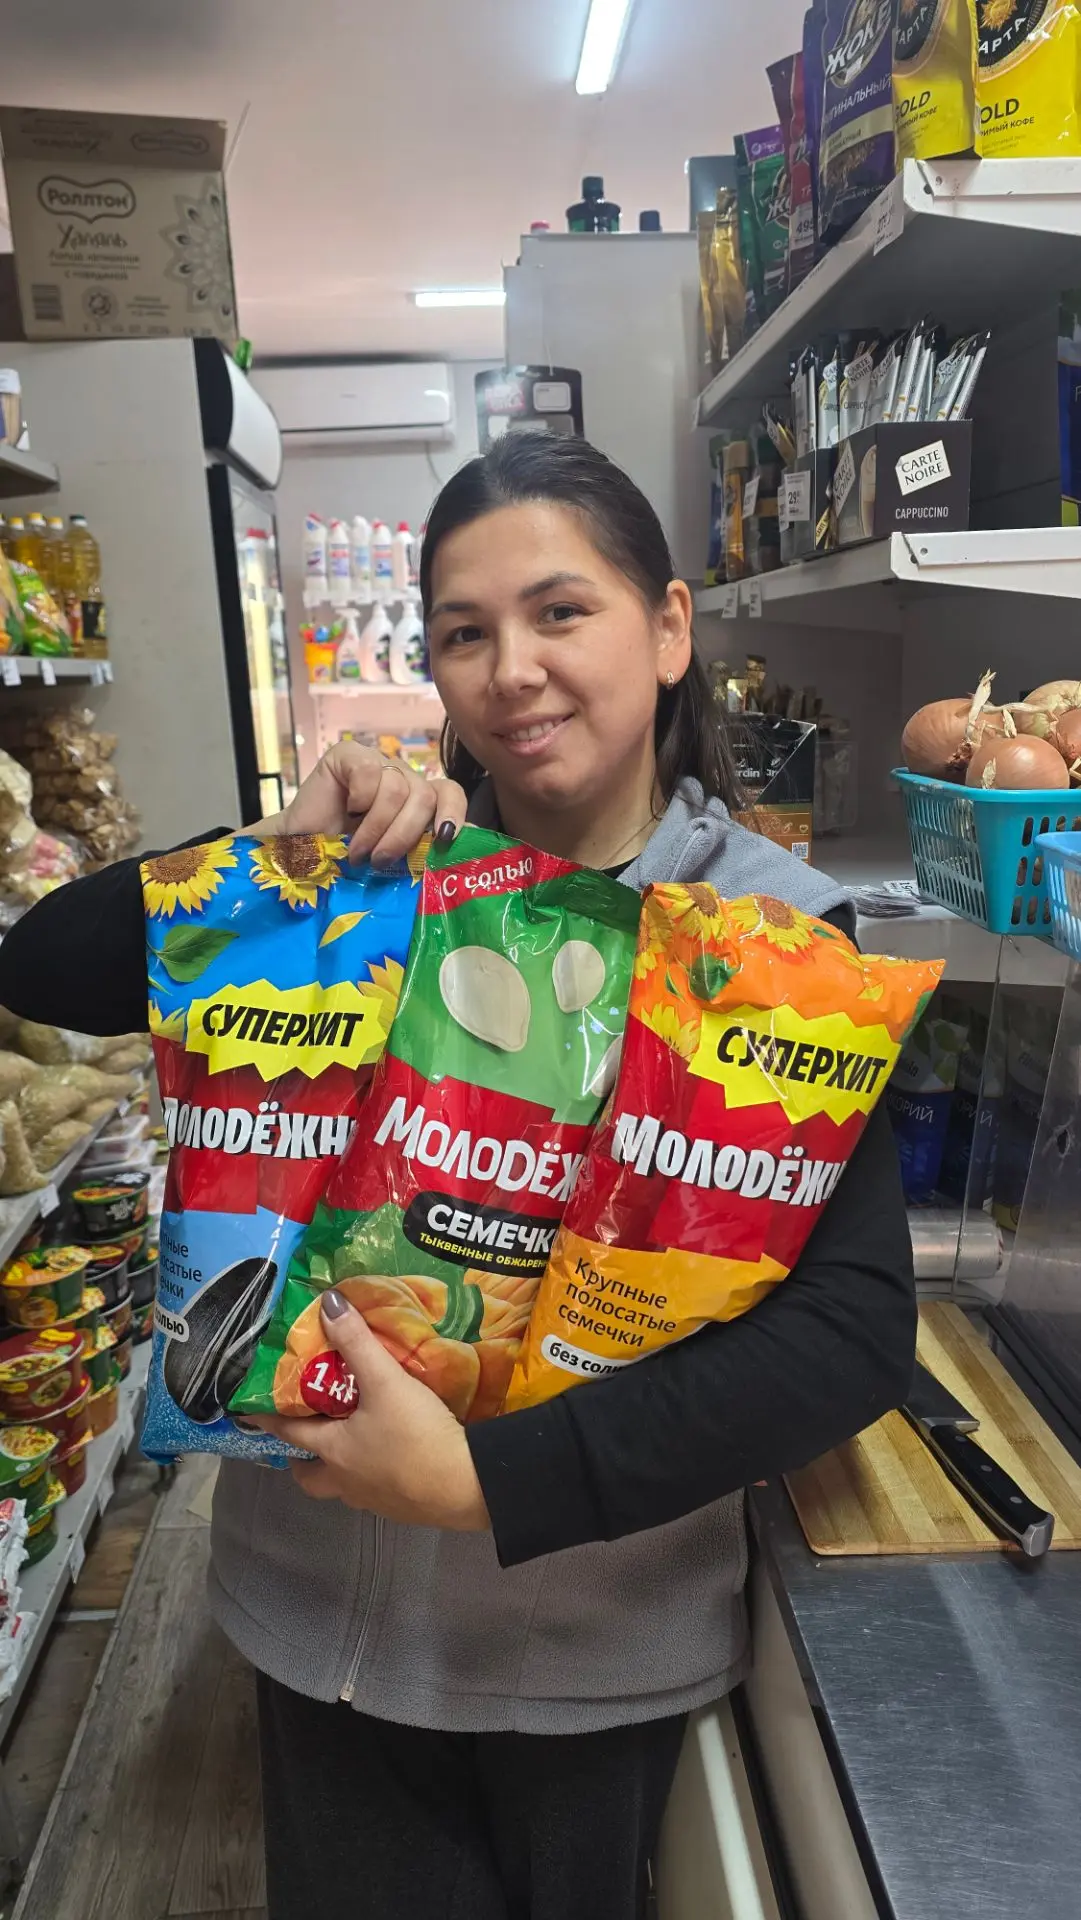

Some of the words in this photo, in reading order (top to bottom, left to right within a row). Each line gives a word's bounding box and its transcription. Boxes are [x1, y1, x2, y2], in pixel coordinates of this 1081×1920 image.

[1009, 116, 1035, 129] КОФЕ
[901, 449, 941, 473] CARTE
[904, 461, 945, 486] NOIRE
[895, 506, 949, 520] CAPPUCCINO
[442, 874, 458, 898] С
[464, 857, 533, 890] солью
[201, 1003, 364, 1048] СУПЕРХИТ
[716, 1026, 888, 1095] СУПЕРХИТ
[427, 1203, 556, 1254] СЕМЕЧК
[419, 1232, 494, 1263] ТЫКВЕННЫЕ
[574, 1257, 668, 1310] Крупные
[558, 1303, 645, 1347] семечки
[565, 1282, 677, 1334] полосатые
[549, 1342, 579, 1367] без
[306, 1361, 330, 1393] 1
